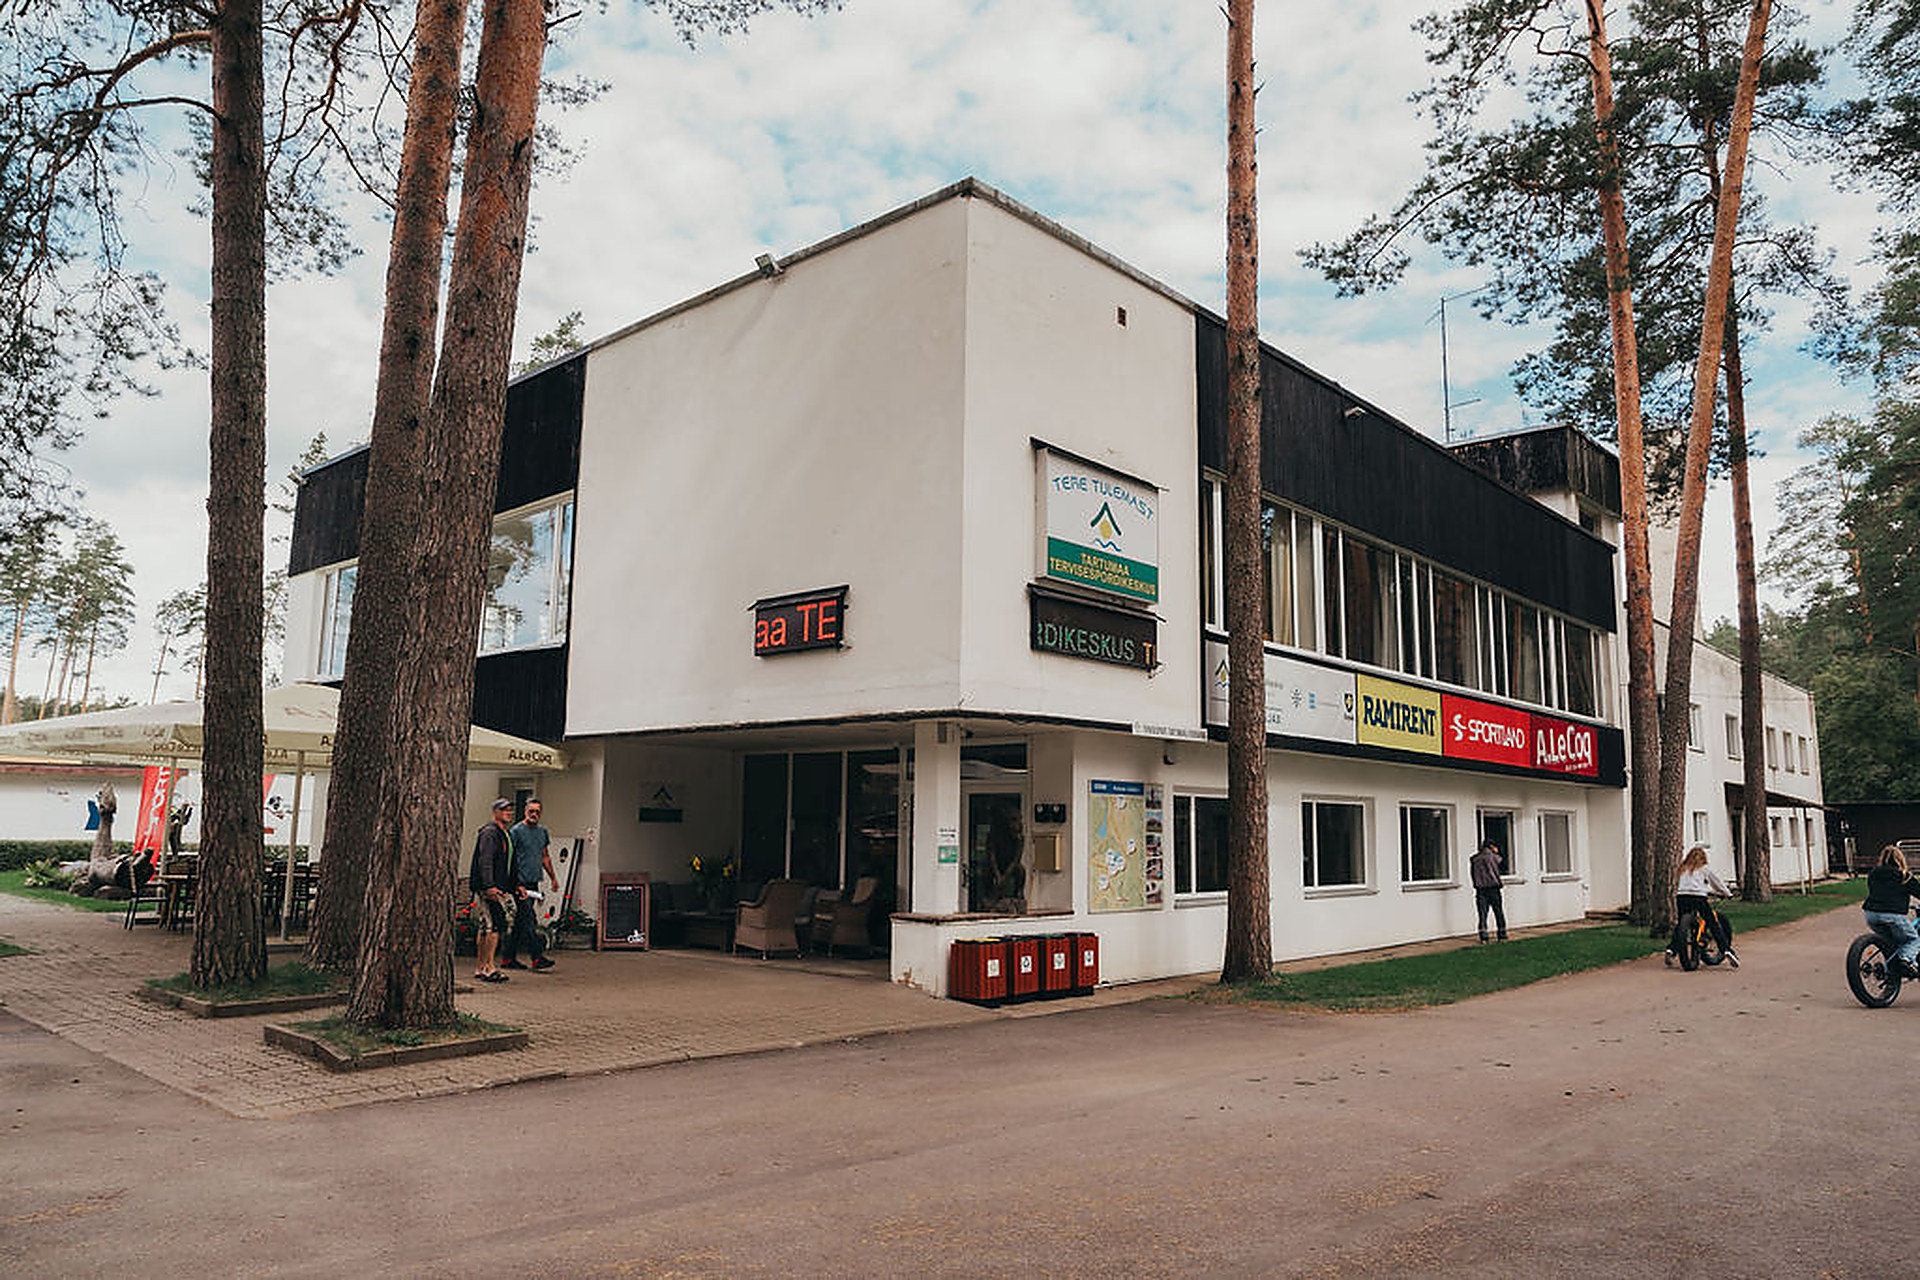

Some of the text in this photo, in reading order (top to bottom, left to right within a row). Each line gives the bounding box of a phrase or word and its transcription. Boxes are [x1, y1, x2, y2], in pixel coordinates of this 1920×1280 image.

[1052, 476, 1154, 520] TERE TULEMAST
[1050, 556, 1156, 596] TERVISESPORDIKESKUS
[1080, 552, 1132, 576] TARTUMAA
[796, 600, 837, 642] TE
[1362, 694, 1437, 737] RAMIRENT
[1467, 719, 1526, 749] SPORTLAND
